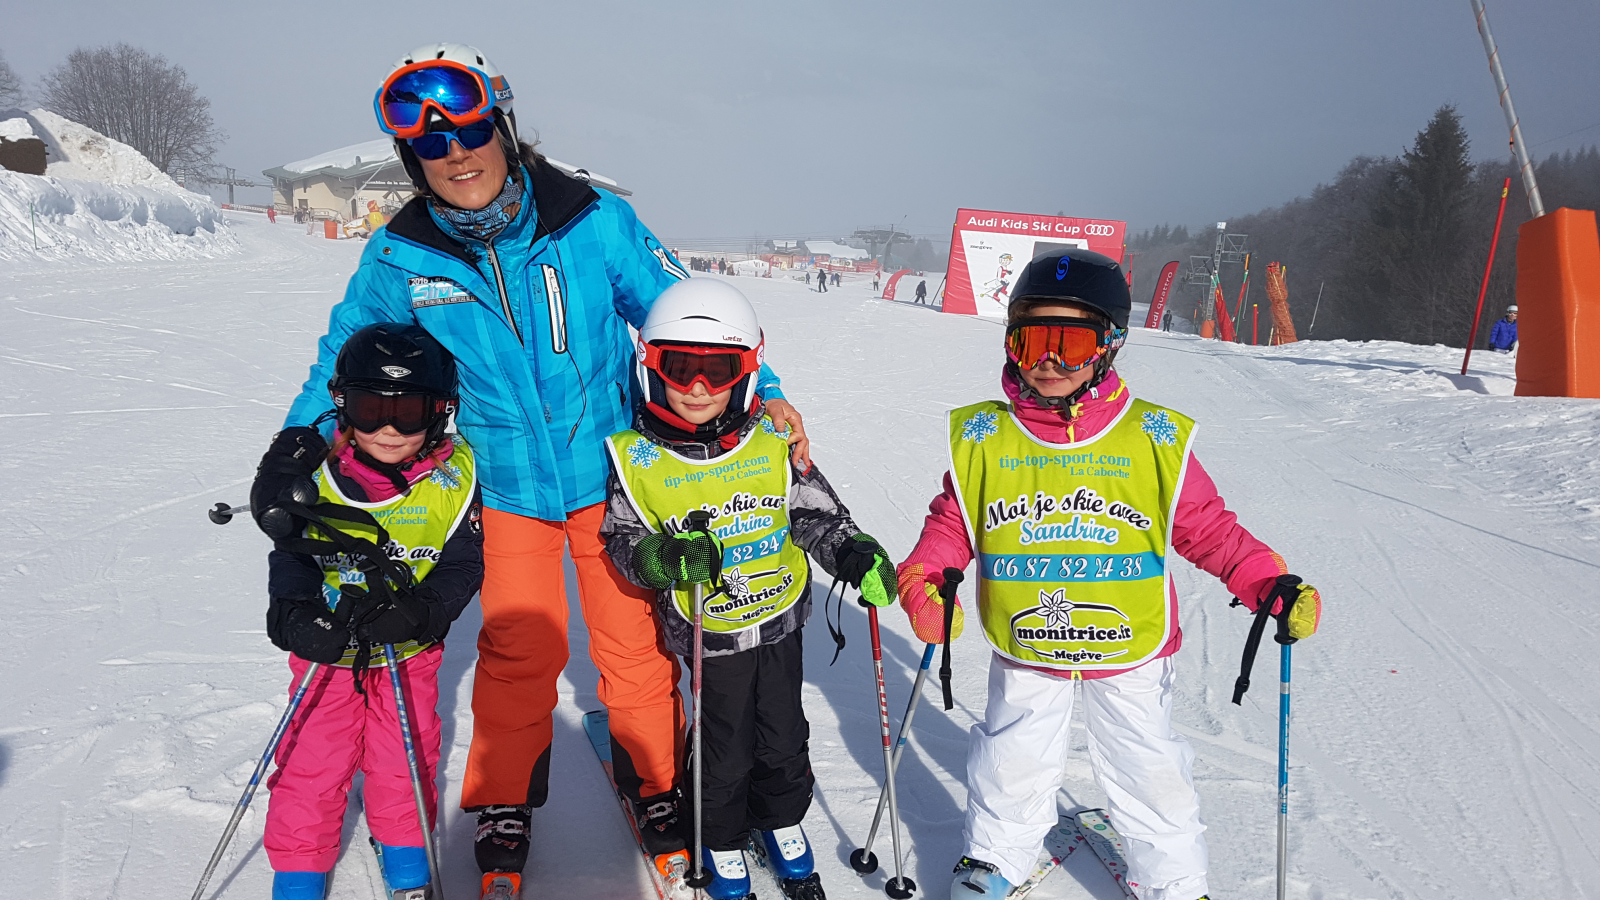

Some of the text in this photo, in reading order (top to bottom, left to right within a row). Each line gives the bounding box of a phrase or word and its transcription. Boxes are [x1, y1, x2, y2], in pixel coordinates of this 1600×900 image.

[967, 216, 1081, 236] Audi Kids Ski Cup
[1151, 271, 1174, 328] udi quattro
[663, 455, 770, 489] tip-top-sport.com
[999, 452, 1131, 471] tip-top-sport.com
[722, 466, 772, 483] La Caboche
[1070, 466, 1130, 479] La Caboche
[665, 517, 693, 535] Mo
[723, 493, 757, 515] skie
[985, 488, 1150, 530] Moi je skie avec
[388, 516, 428, 525] Caboche
[714, 514, 773, 539] ndrine
[1021, 517, 1117, 543] Sandrine
[411, 547, 441, 562] ave
[732, 535, 780, 563] 82 24
[993, 556, 1143, 579] 06 87 82 24 38
[709, 573, 793, 614] monitrice.fr
[741, 604, 776, 622] Megève
[1017, 624, 1132, 641] monitrice.fr
[1054, 650, 1103, 663] Megève
